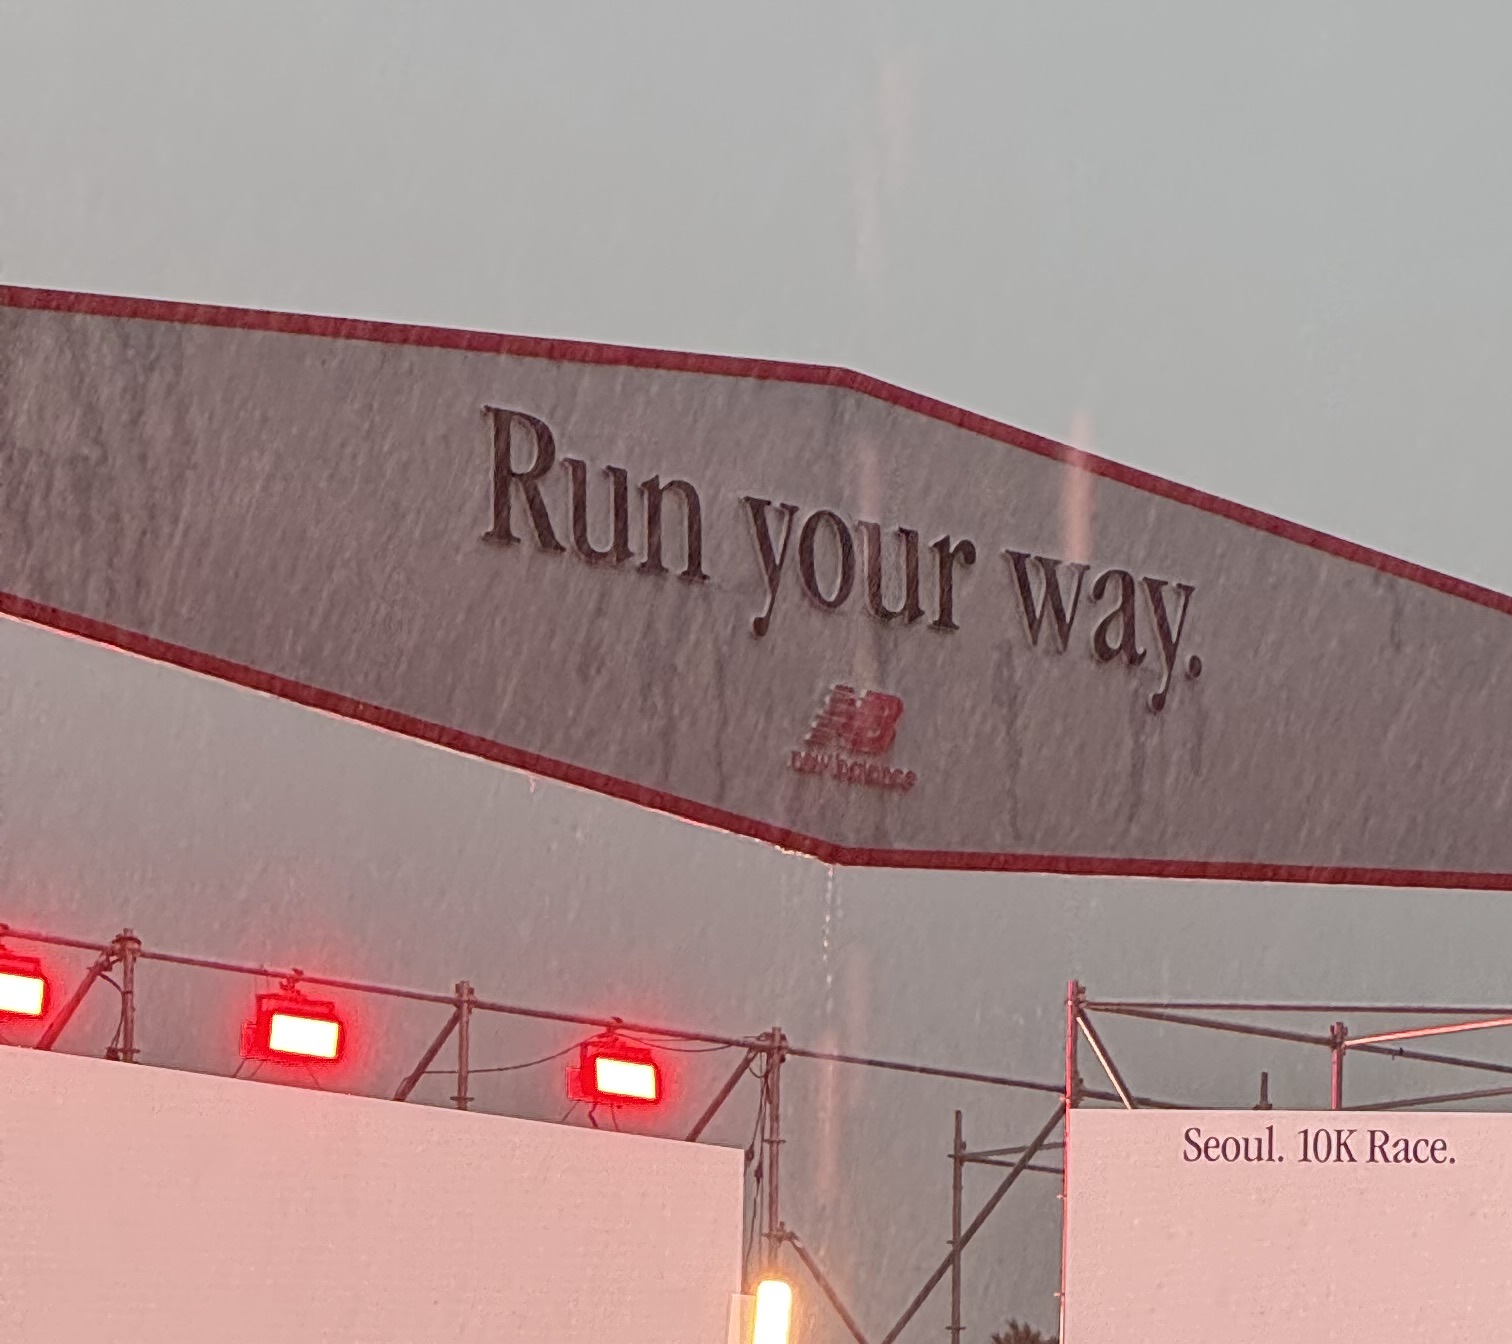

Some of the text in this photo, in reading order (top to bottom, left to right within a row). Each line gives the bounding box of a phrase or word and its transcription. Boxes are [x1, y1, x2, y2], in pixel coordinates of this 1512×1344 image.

[481, 405, 1203, 714] Run your way.
[1183, 1125, 1456, 1165] Seoul. 10K Race.
